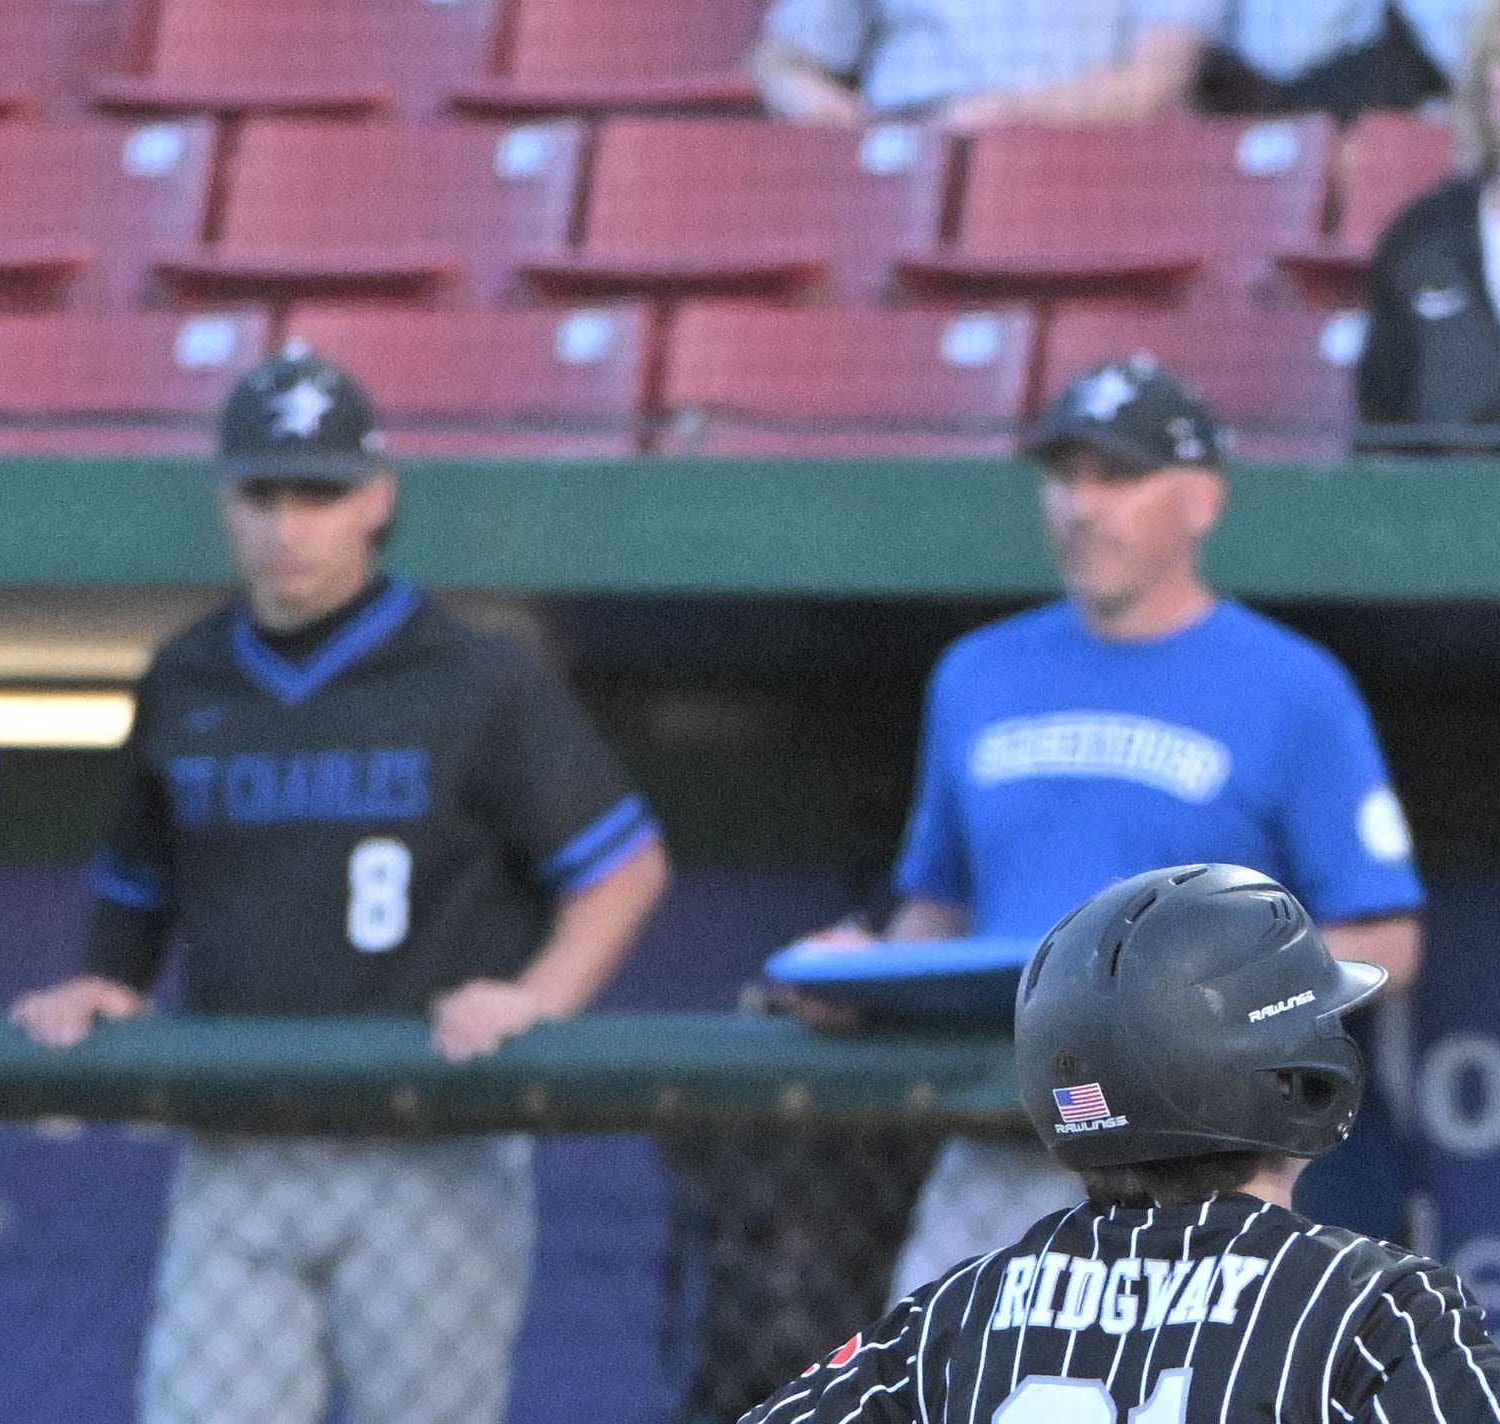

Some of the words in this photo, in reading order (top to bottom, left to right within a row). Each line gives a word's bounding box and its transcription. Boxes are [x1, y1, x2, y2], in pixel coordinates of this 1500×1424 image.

[348, 836, 412, 952] 8
[1248, 989, 1317, 1024] RAWLINGS
[1054, 1115, 1130, 1134] RAWLINGS
[991, 1252, 1269, 1335] RIDGWAY
